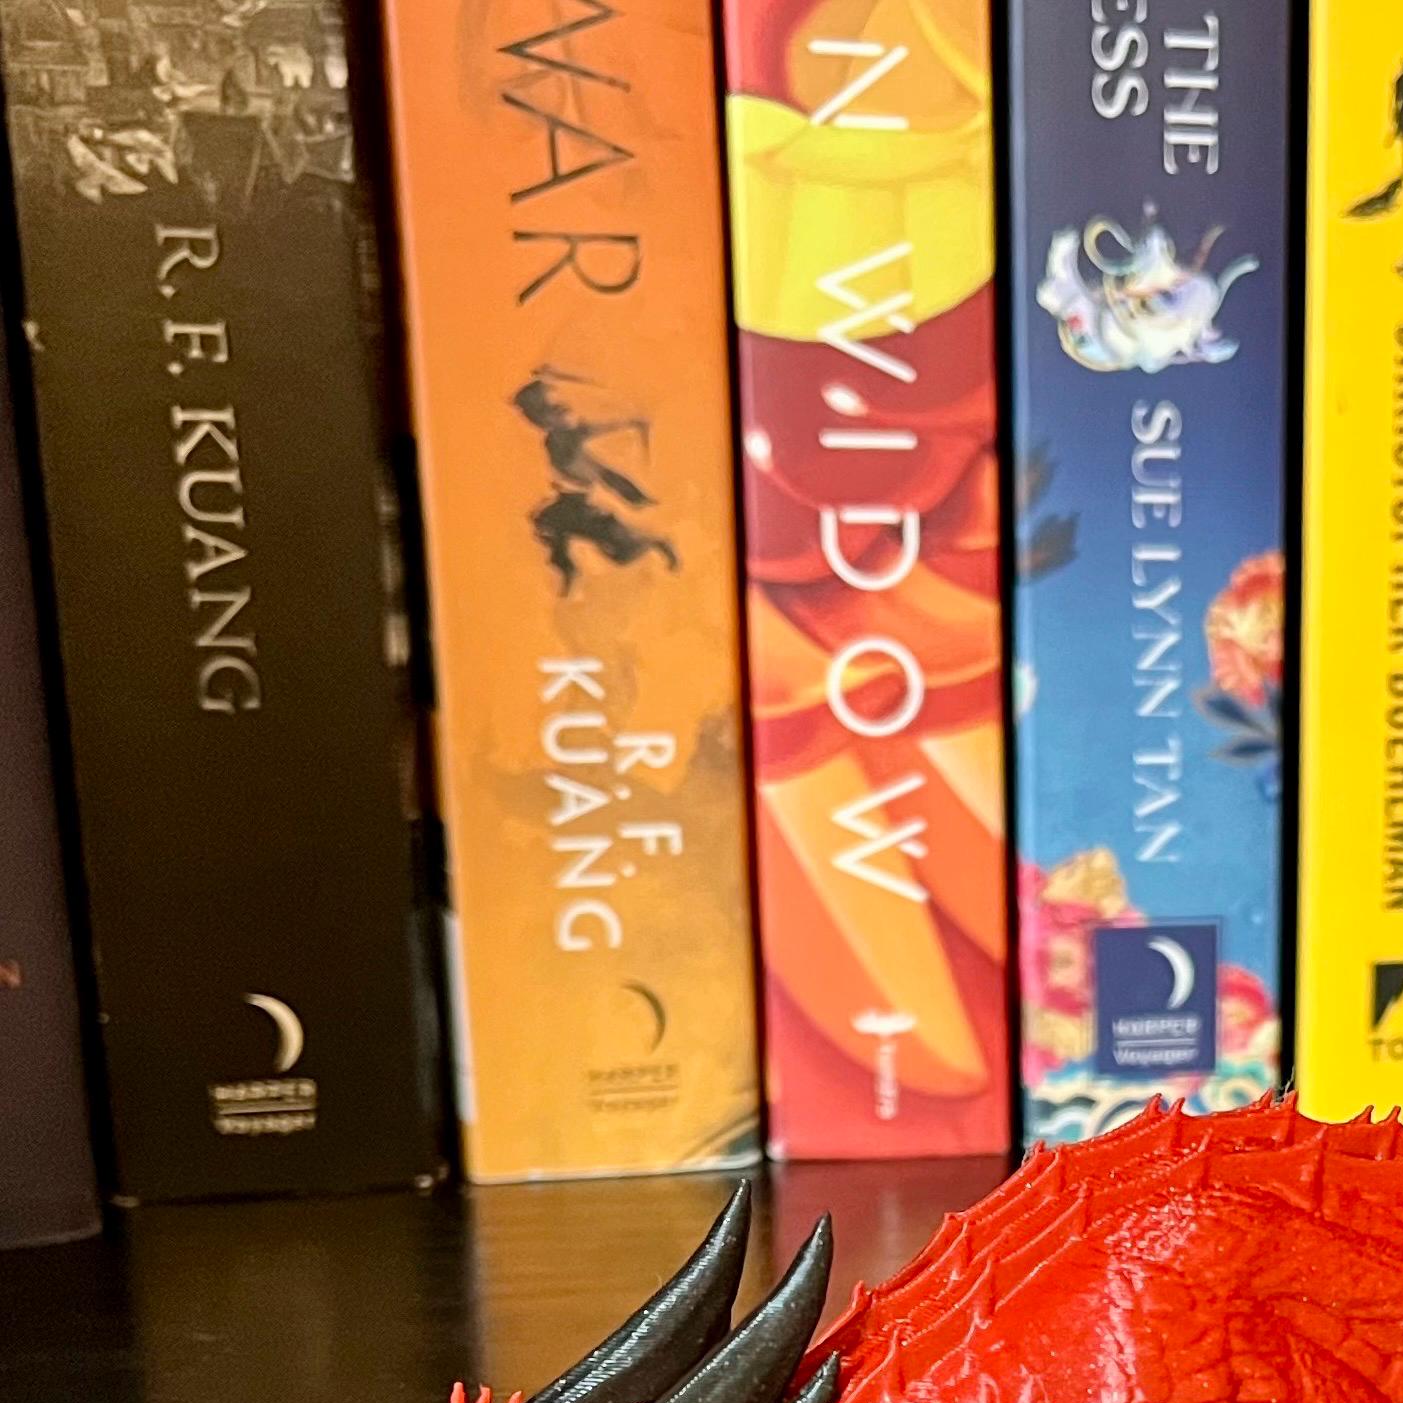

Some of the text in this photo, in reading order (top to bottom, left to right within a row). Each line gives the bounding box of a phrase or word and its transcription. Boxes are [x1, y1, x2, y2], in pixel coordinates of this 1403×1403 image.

[1163, 14, 1219, 175] THE
[153, 221, 261, 714] R. F. KUANG
[815, 240, 930, 905] WIDOW
[1130, 399, 1184, 863] SUE LYNN TAN
[538, 656, 624, 952] KUANG
[611, 732, 684, 879] R. F.
